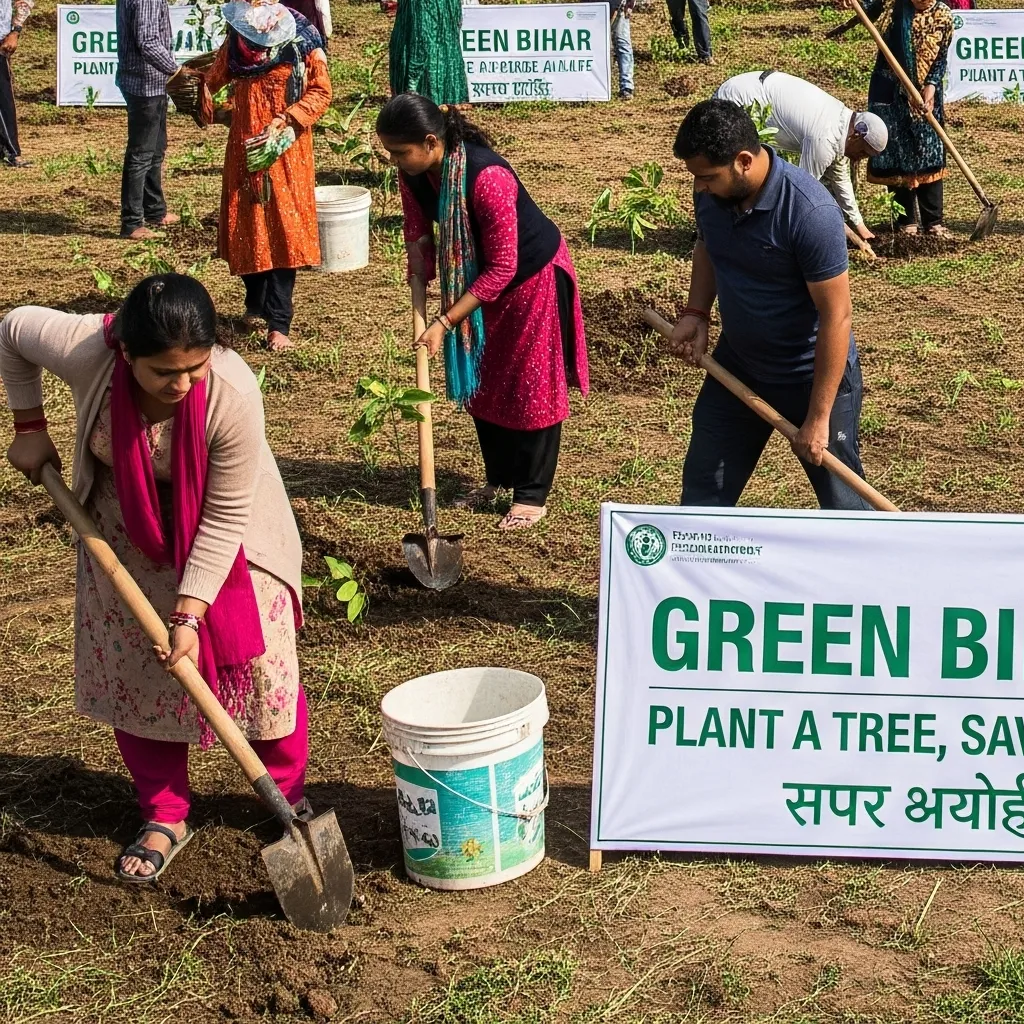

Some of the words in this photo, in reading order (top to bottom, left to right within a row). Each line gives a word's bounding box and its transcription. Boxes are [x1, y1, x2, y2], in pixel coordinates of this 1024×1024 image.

[72, 31, 118, 53] GRE
[461, 28, 509, 52] EEN
[516, 28, 592, 51] BIHAR
[650, 596, 911, 679] GREEN
[648, 704, 784, 750] PLANT
[792, 710, 821, 751] A
[832, 710, 948, 763] TREE,
[782, 781, 892, 829] सपर
